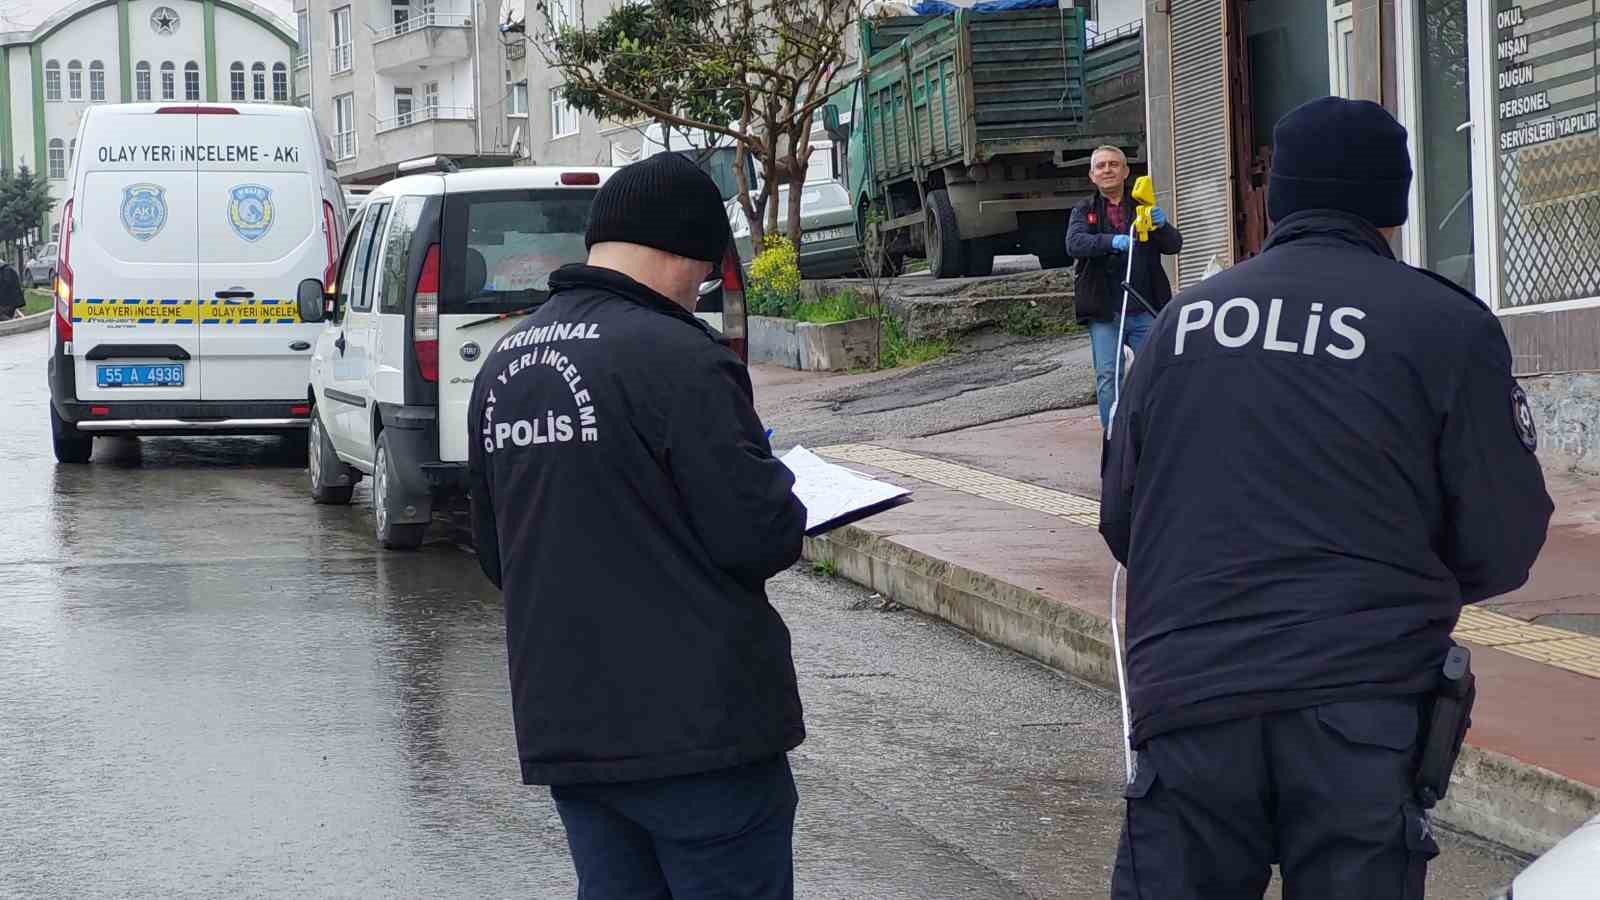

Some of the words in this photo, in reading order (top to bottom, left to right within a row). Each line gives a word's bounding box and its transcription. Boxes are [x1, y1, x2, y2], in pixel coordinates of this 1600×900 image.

[1497, 8, 1524, 29] OKUL
[1497, 36, 1527, 61] NİŞAN
[1500, 92, 1549, 119] PERSONEL
[1558, 112, 1597, 136] YAPILIR
[98, 146, 137, 162] OLAY
[87, 305, 112, 316] OLAY
[212, 307, 237, 317] OLAY
[105, 368, 122, 382] 55
[130, 368, 138, 381] A
[148, 367, 181, 382] 4936
[483, 388, 496, 453] OLAY
